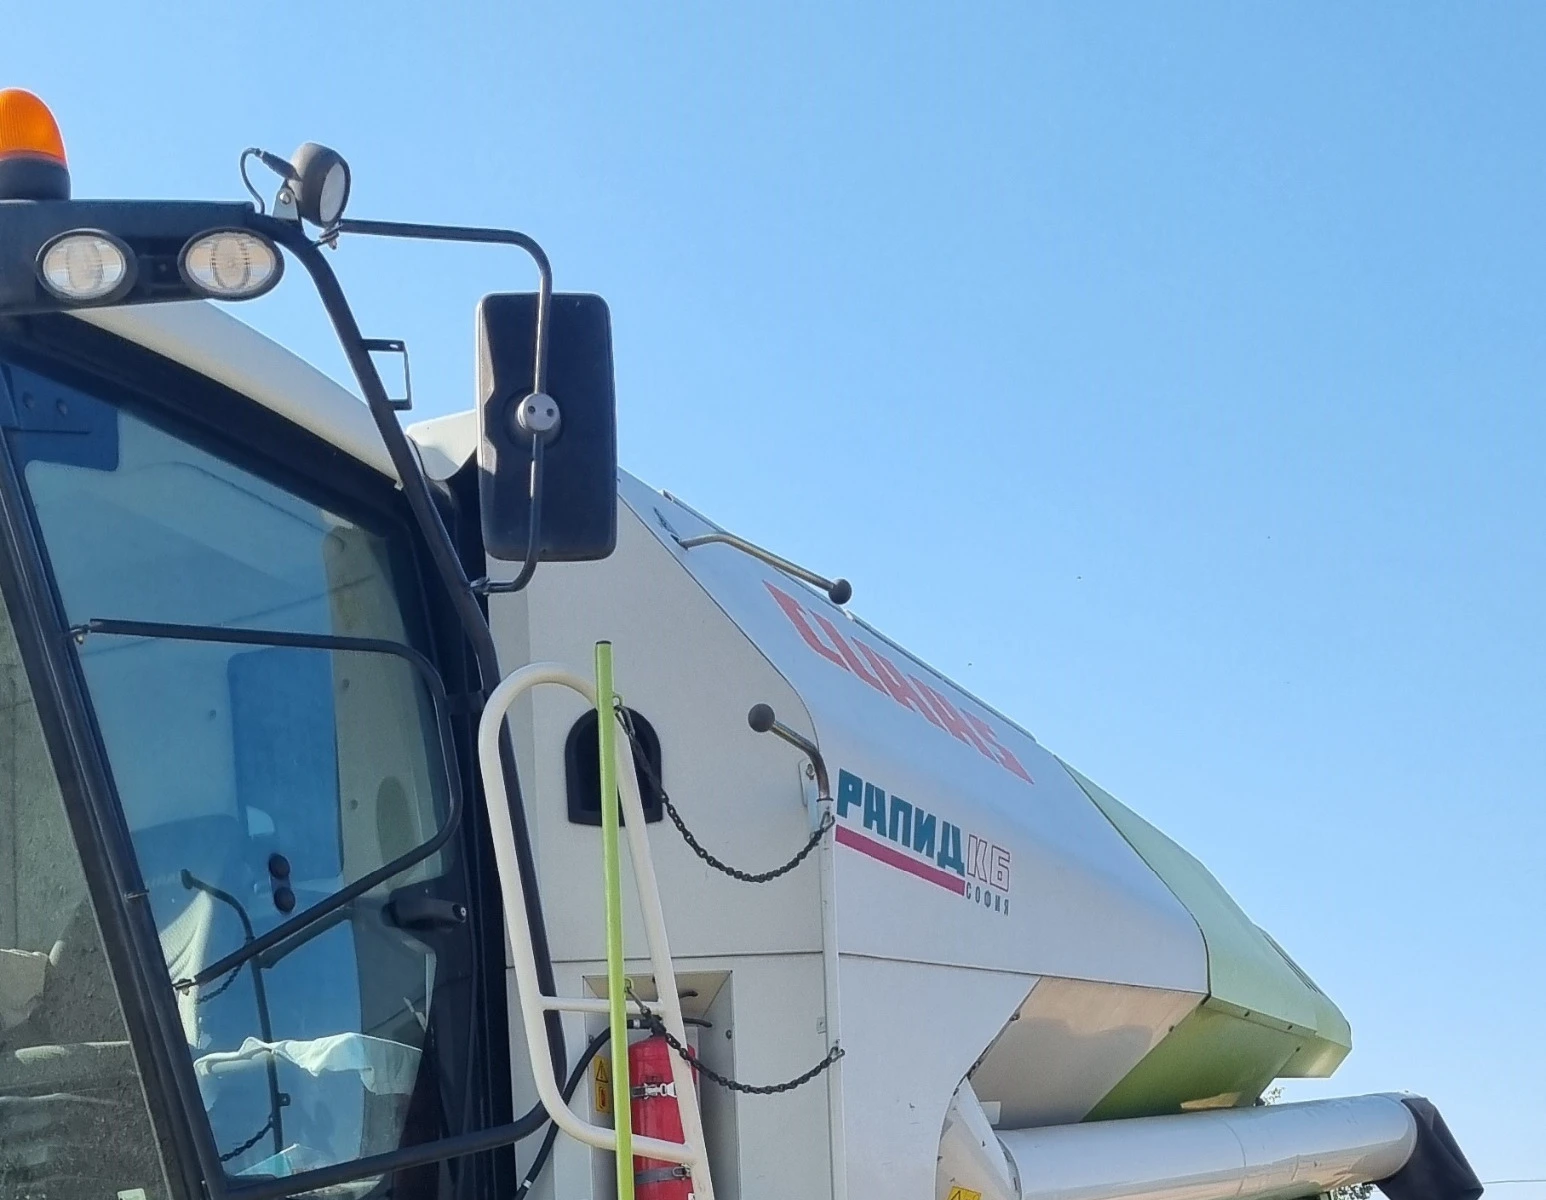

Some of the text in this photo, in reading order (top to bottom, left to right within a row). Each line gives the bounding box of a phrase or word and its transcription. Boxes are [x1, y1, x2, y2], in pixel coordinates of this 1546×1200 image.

[836, 767, 1012, 893] РАПИД КБ
[966, 881, 1010, 916] СОФИЯ
